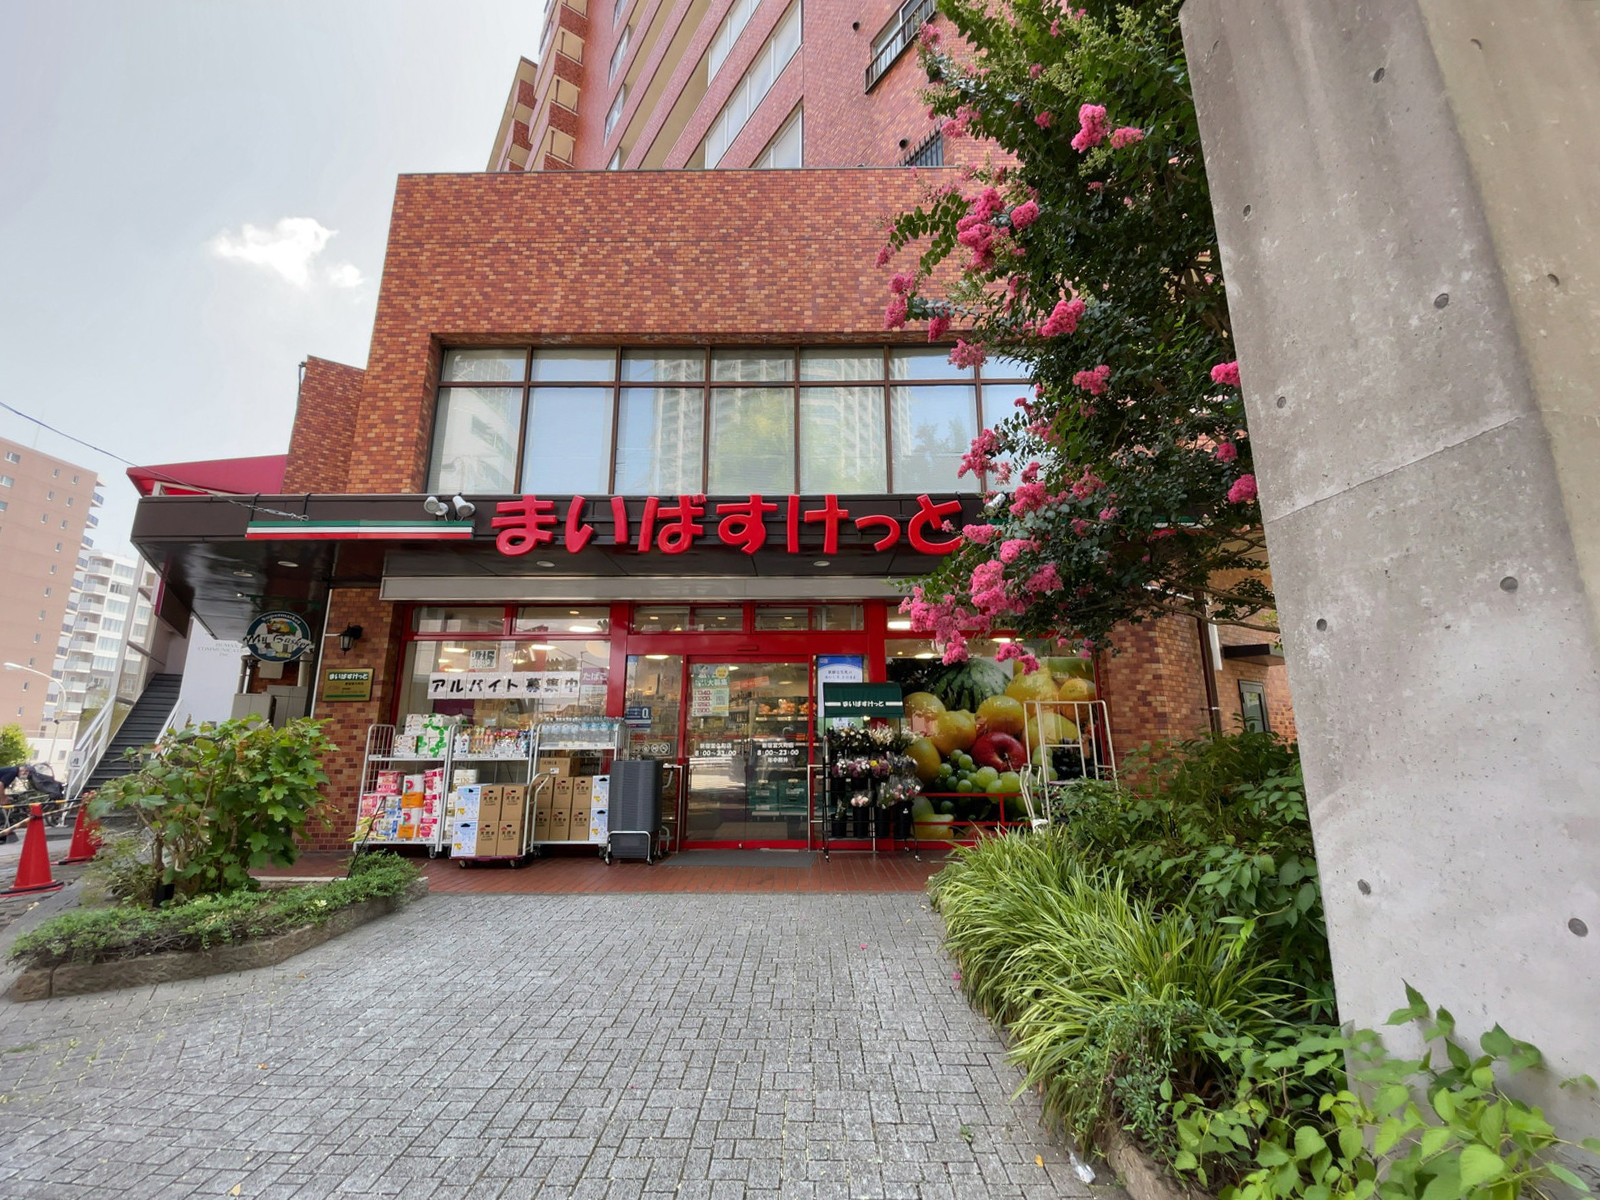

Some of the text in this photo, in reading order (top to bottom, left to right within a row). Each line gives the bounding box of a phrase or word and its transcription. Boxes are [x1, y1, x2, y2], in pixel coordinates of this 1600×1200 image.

[491, 494, 963, 556] まいばすけっと
[261, 613, 302, 624] Supermarket
[243, 633, 310, 649] My Basket
[329, 672, 368, 680] まいばすけっと
